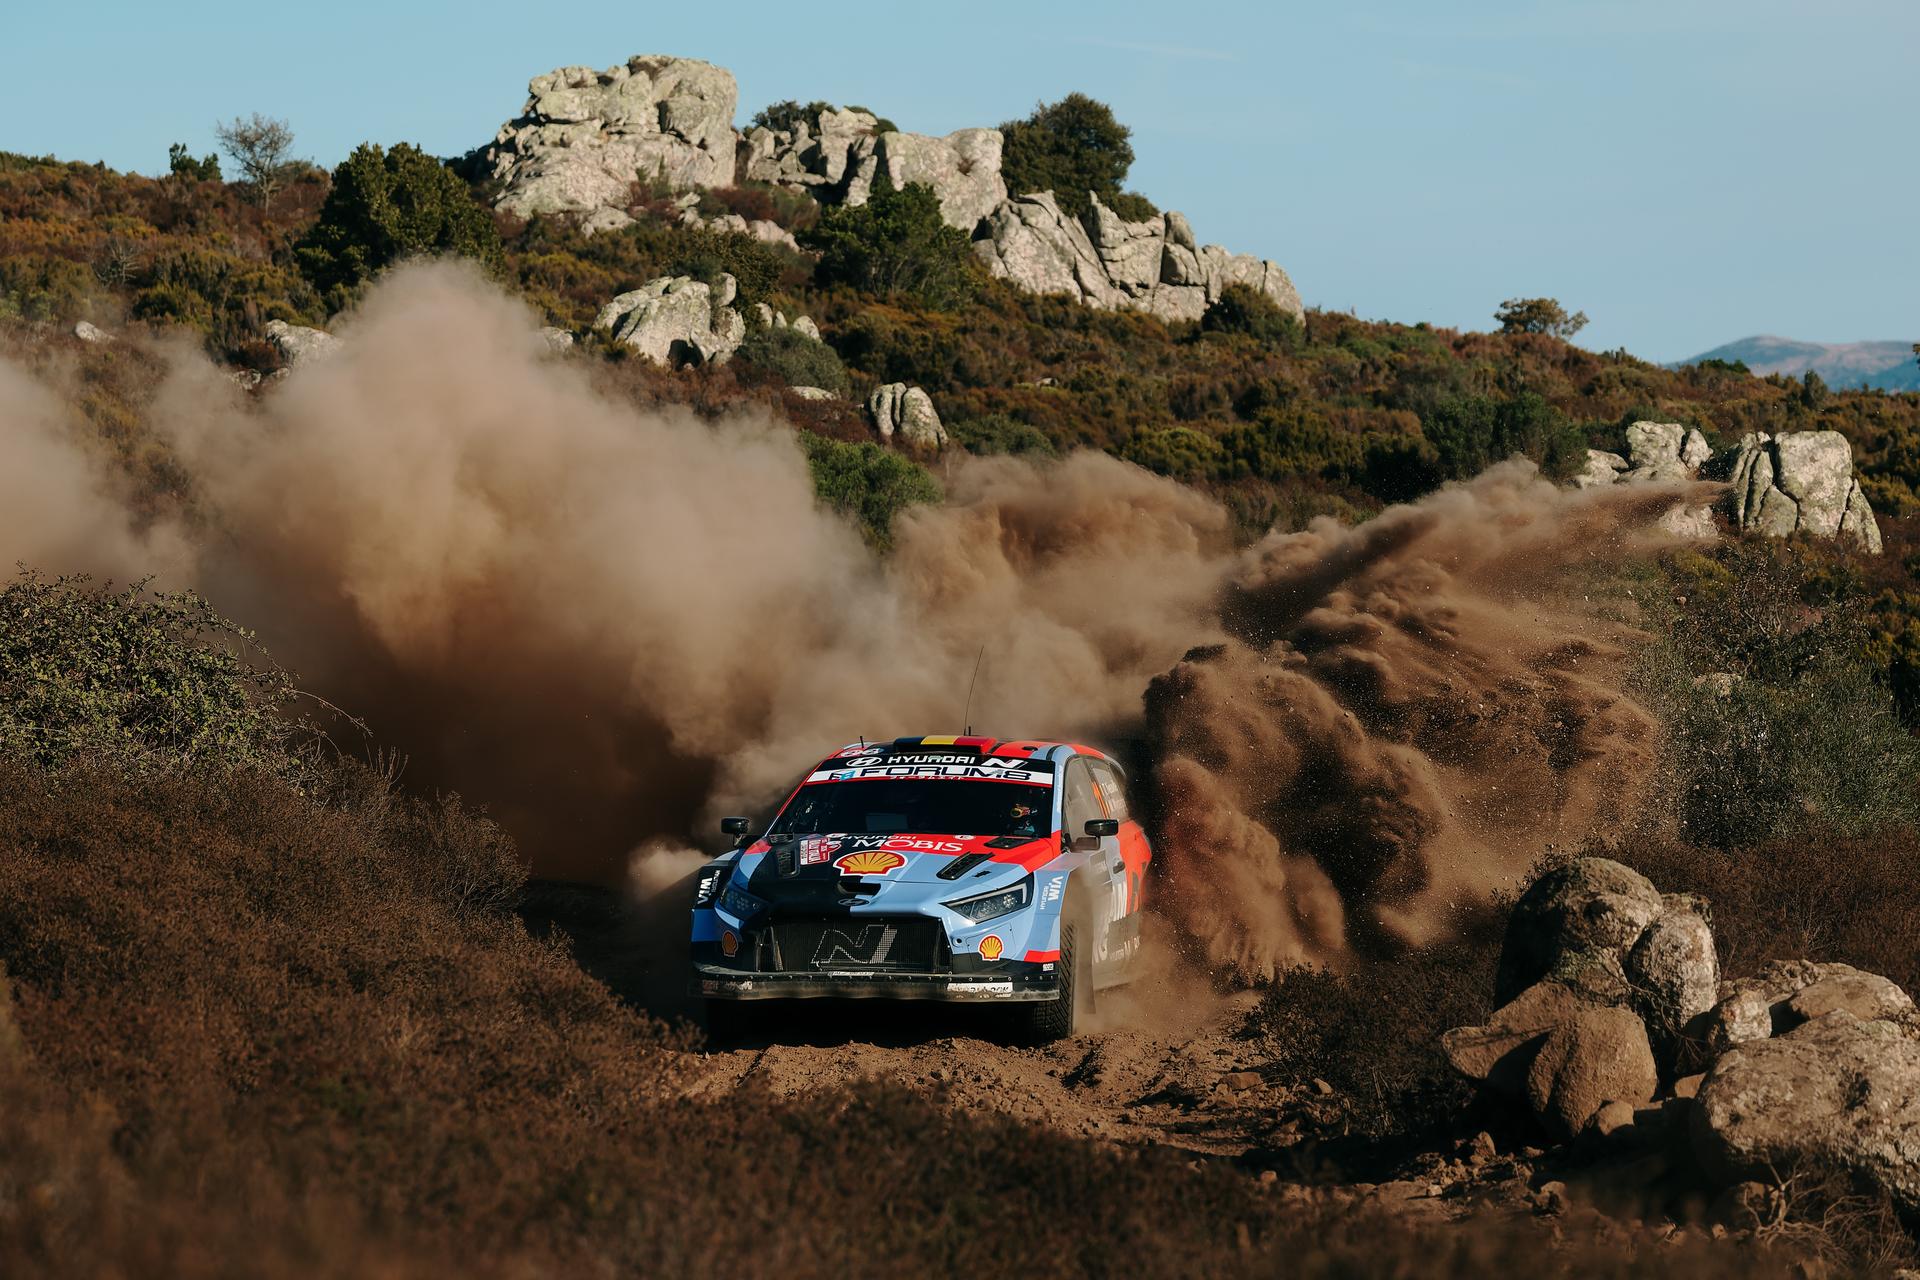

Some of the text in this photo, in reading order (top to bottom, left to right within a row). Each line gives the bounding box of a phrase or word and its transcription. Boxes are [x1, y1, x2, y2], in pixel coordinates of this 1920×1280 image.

[887, 755, 976, 765] HYUNDAI
[860, 766, 1032, 781] FORUM8
[852, 839, 963, 852] MOBIS
